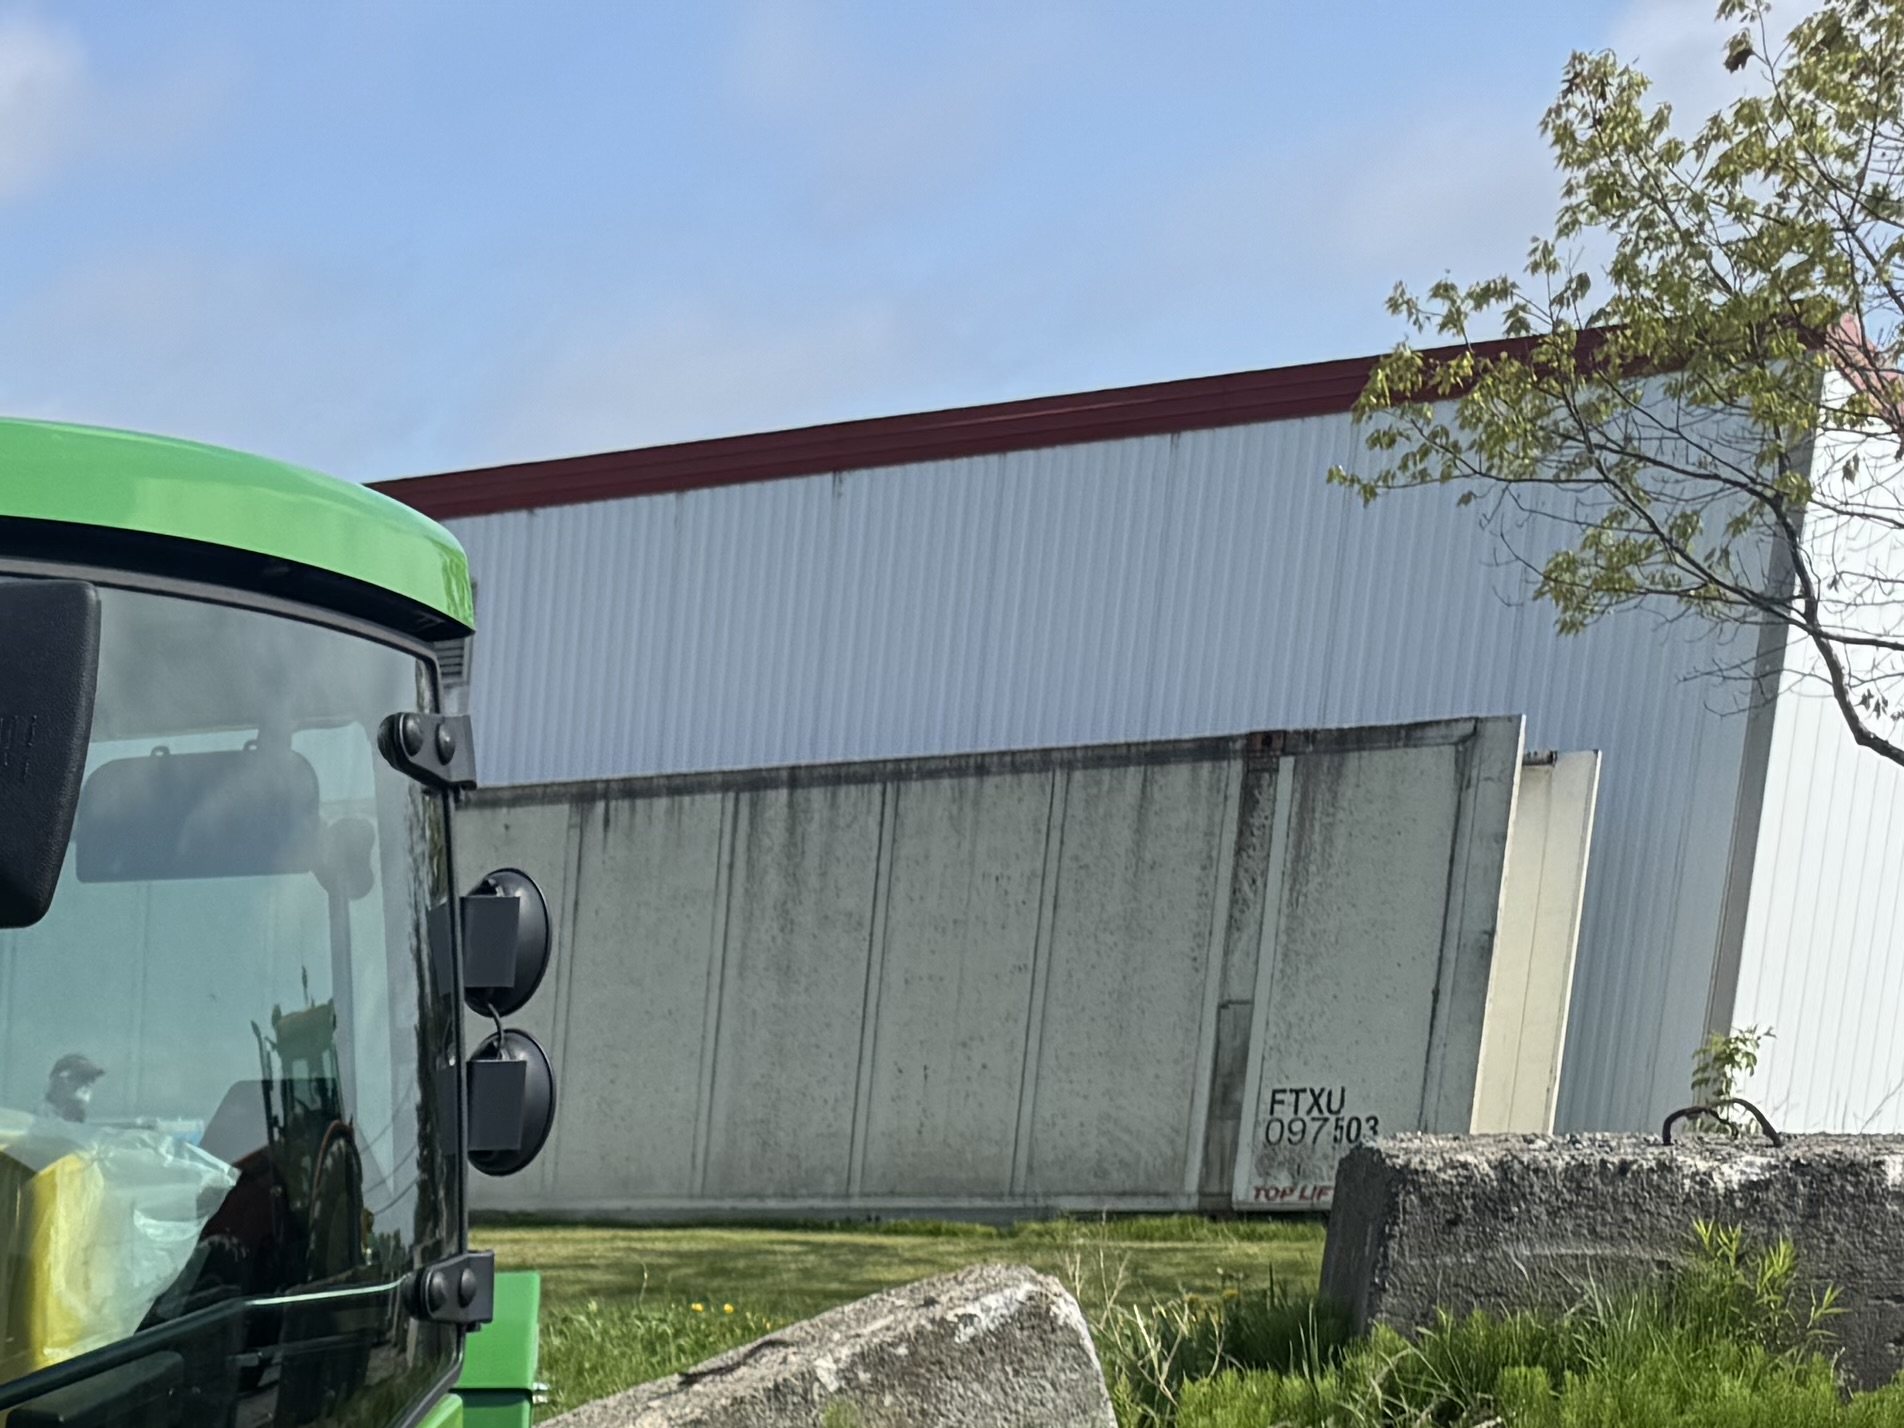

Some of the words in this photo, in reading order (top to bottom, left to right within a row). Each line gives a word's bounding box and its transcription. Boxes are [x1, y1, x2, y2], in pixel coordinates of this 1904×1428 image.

[1269, 1086, 1346, 1116] FTXU
[1265, 1115, 1380, 1146] 097503
[1254, 1184, 1294, 1201] TOP
[1298, 1184, 1334, 1201] LIF
